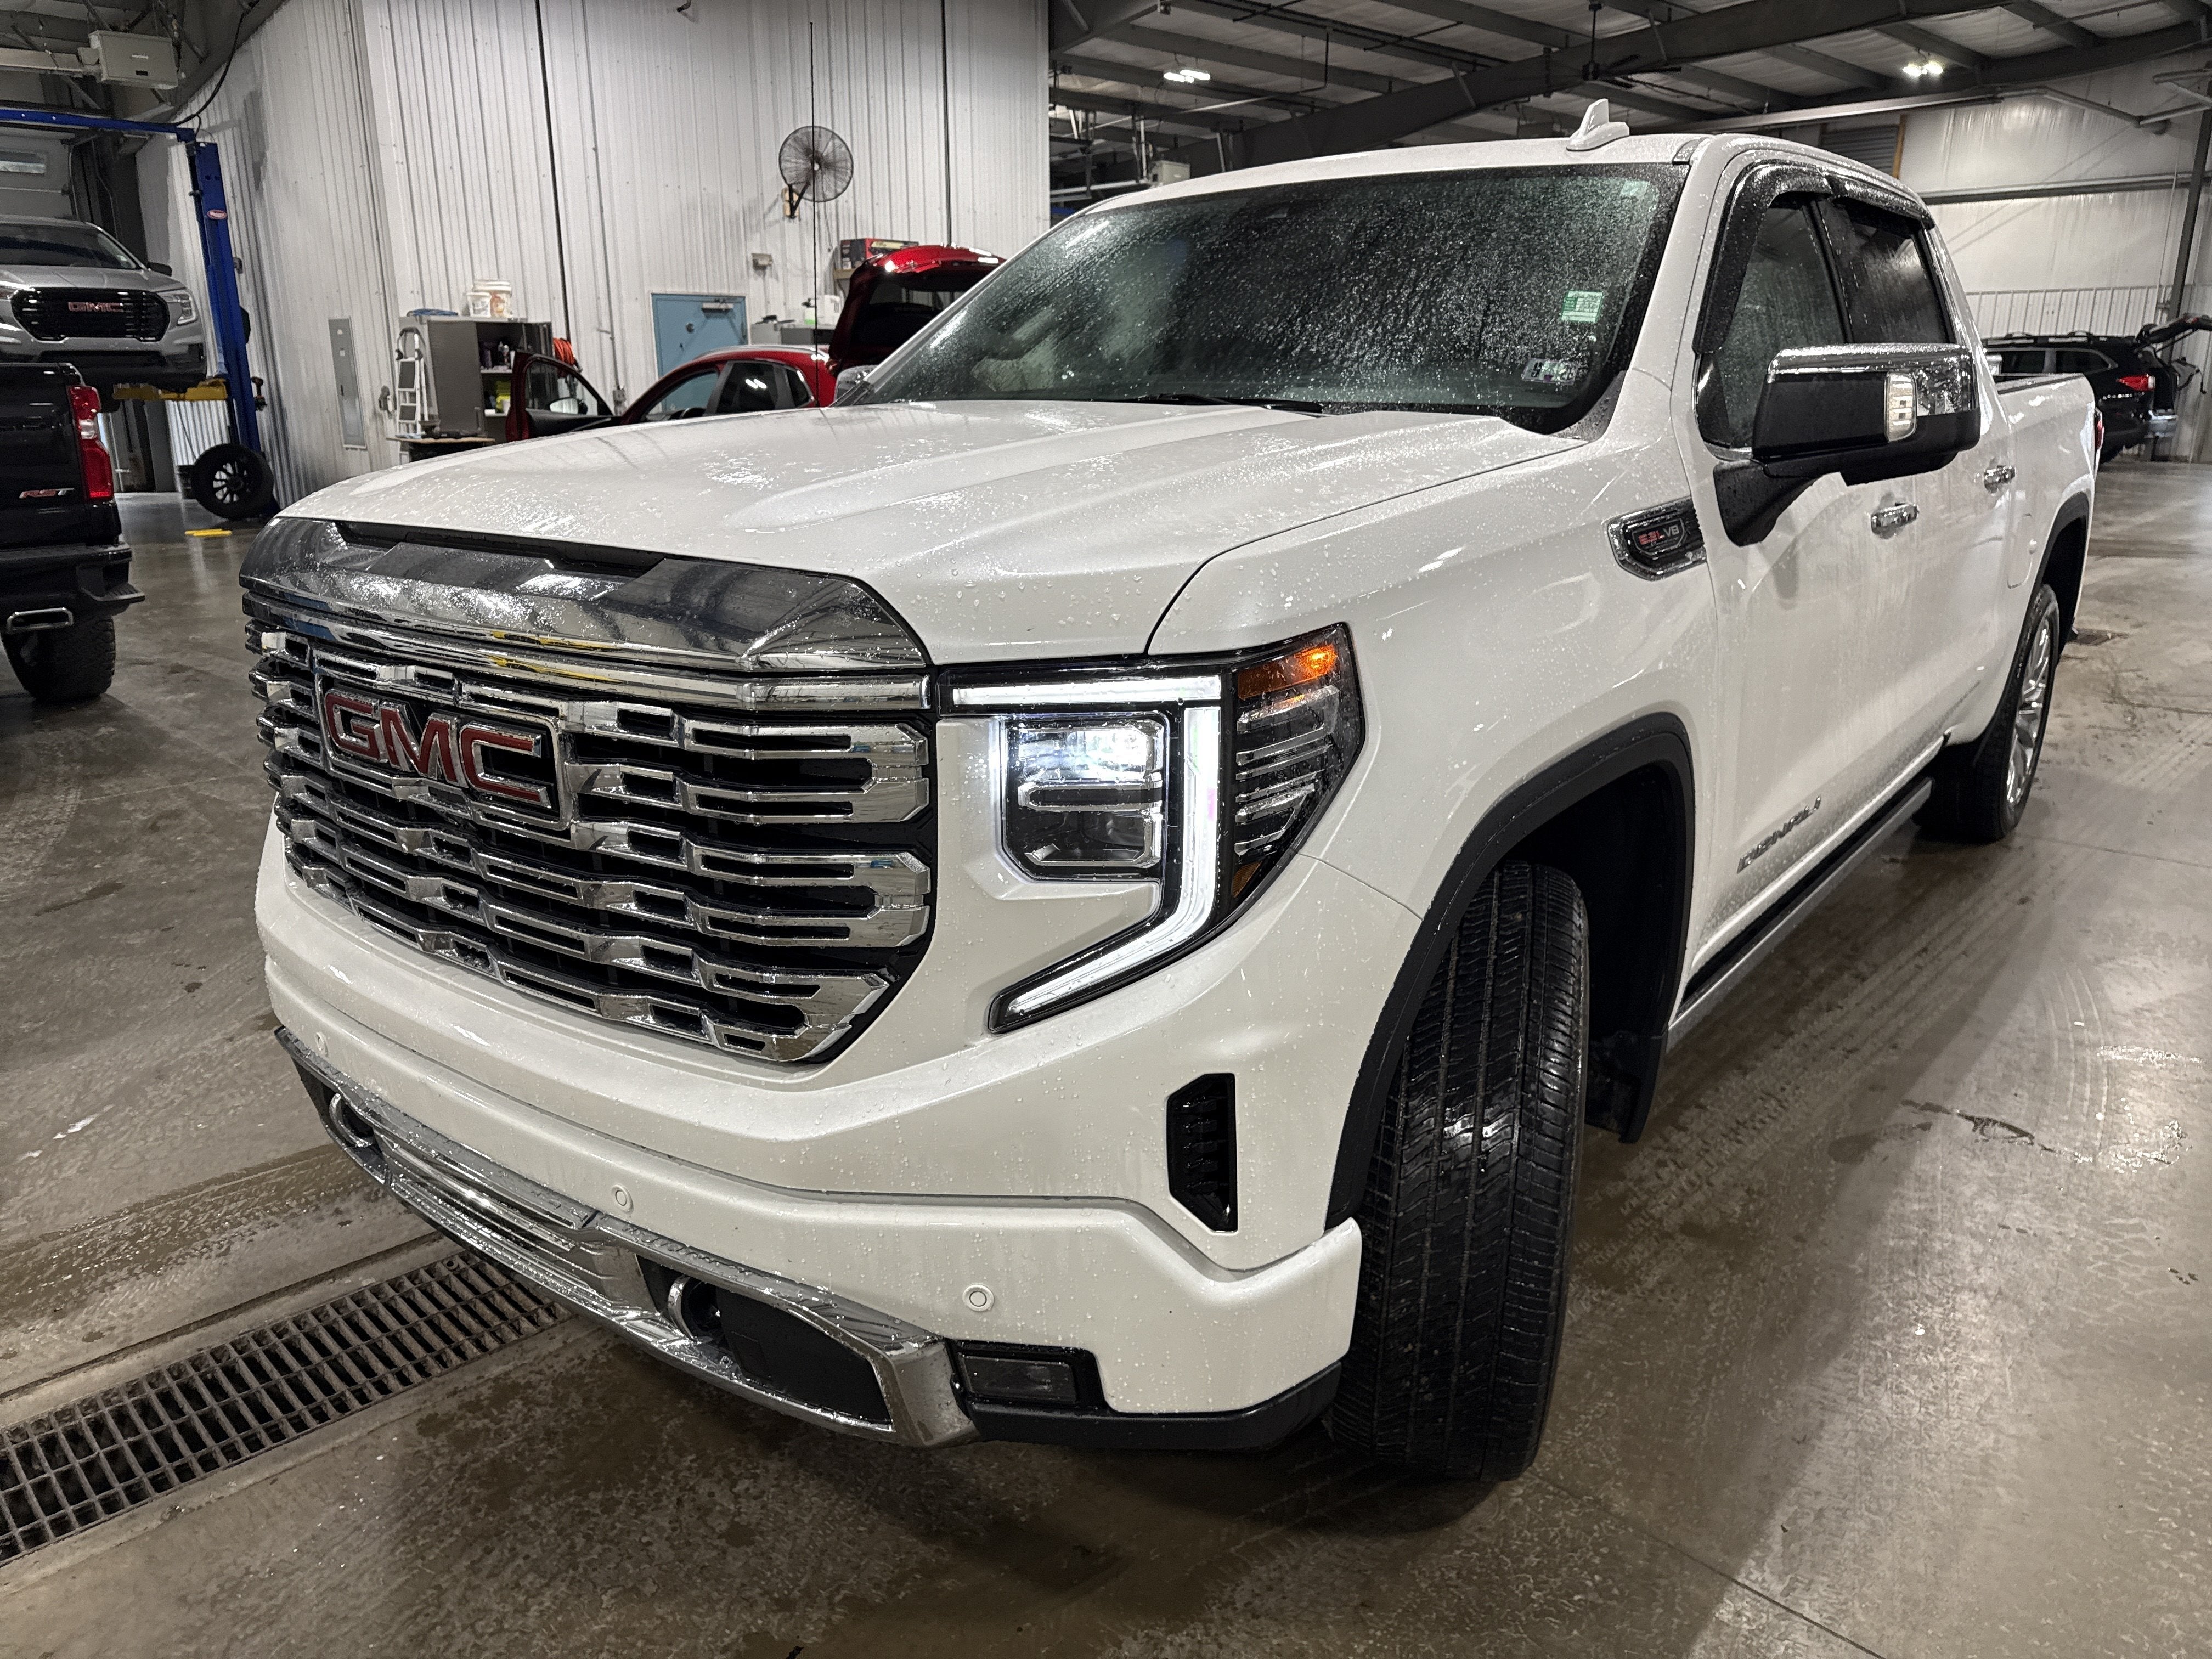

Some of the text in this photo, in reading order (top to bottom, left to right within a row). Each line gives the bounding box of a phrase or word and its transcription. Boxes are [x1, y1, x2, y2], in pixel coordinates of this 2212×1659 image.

[68, 302, 123, 312] GMC
[1663, 524, 1680, 537] V8
[325, 689, 552, 809] GMC
